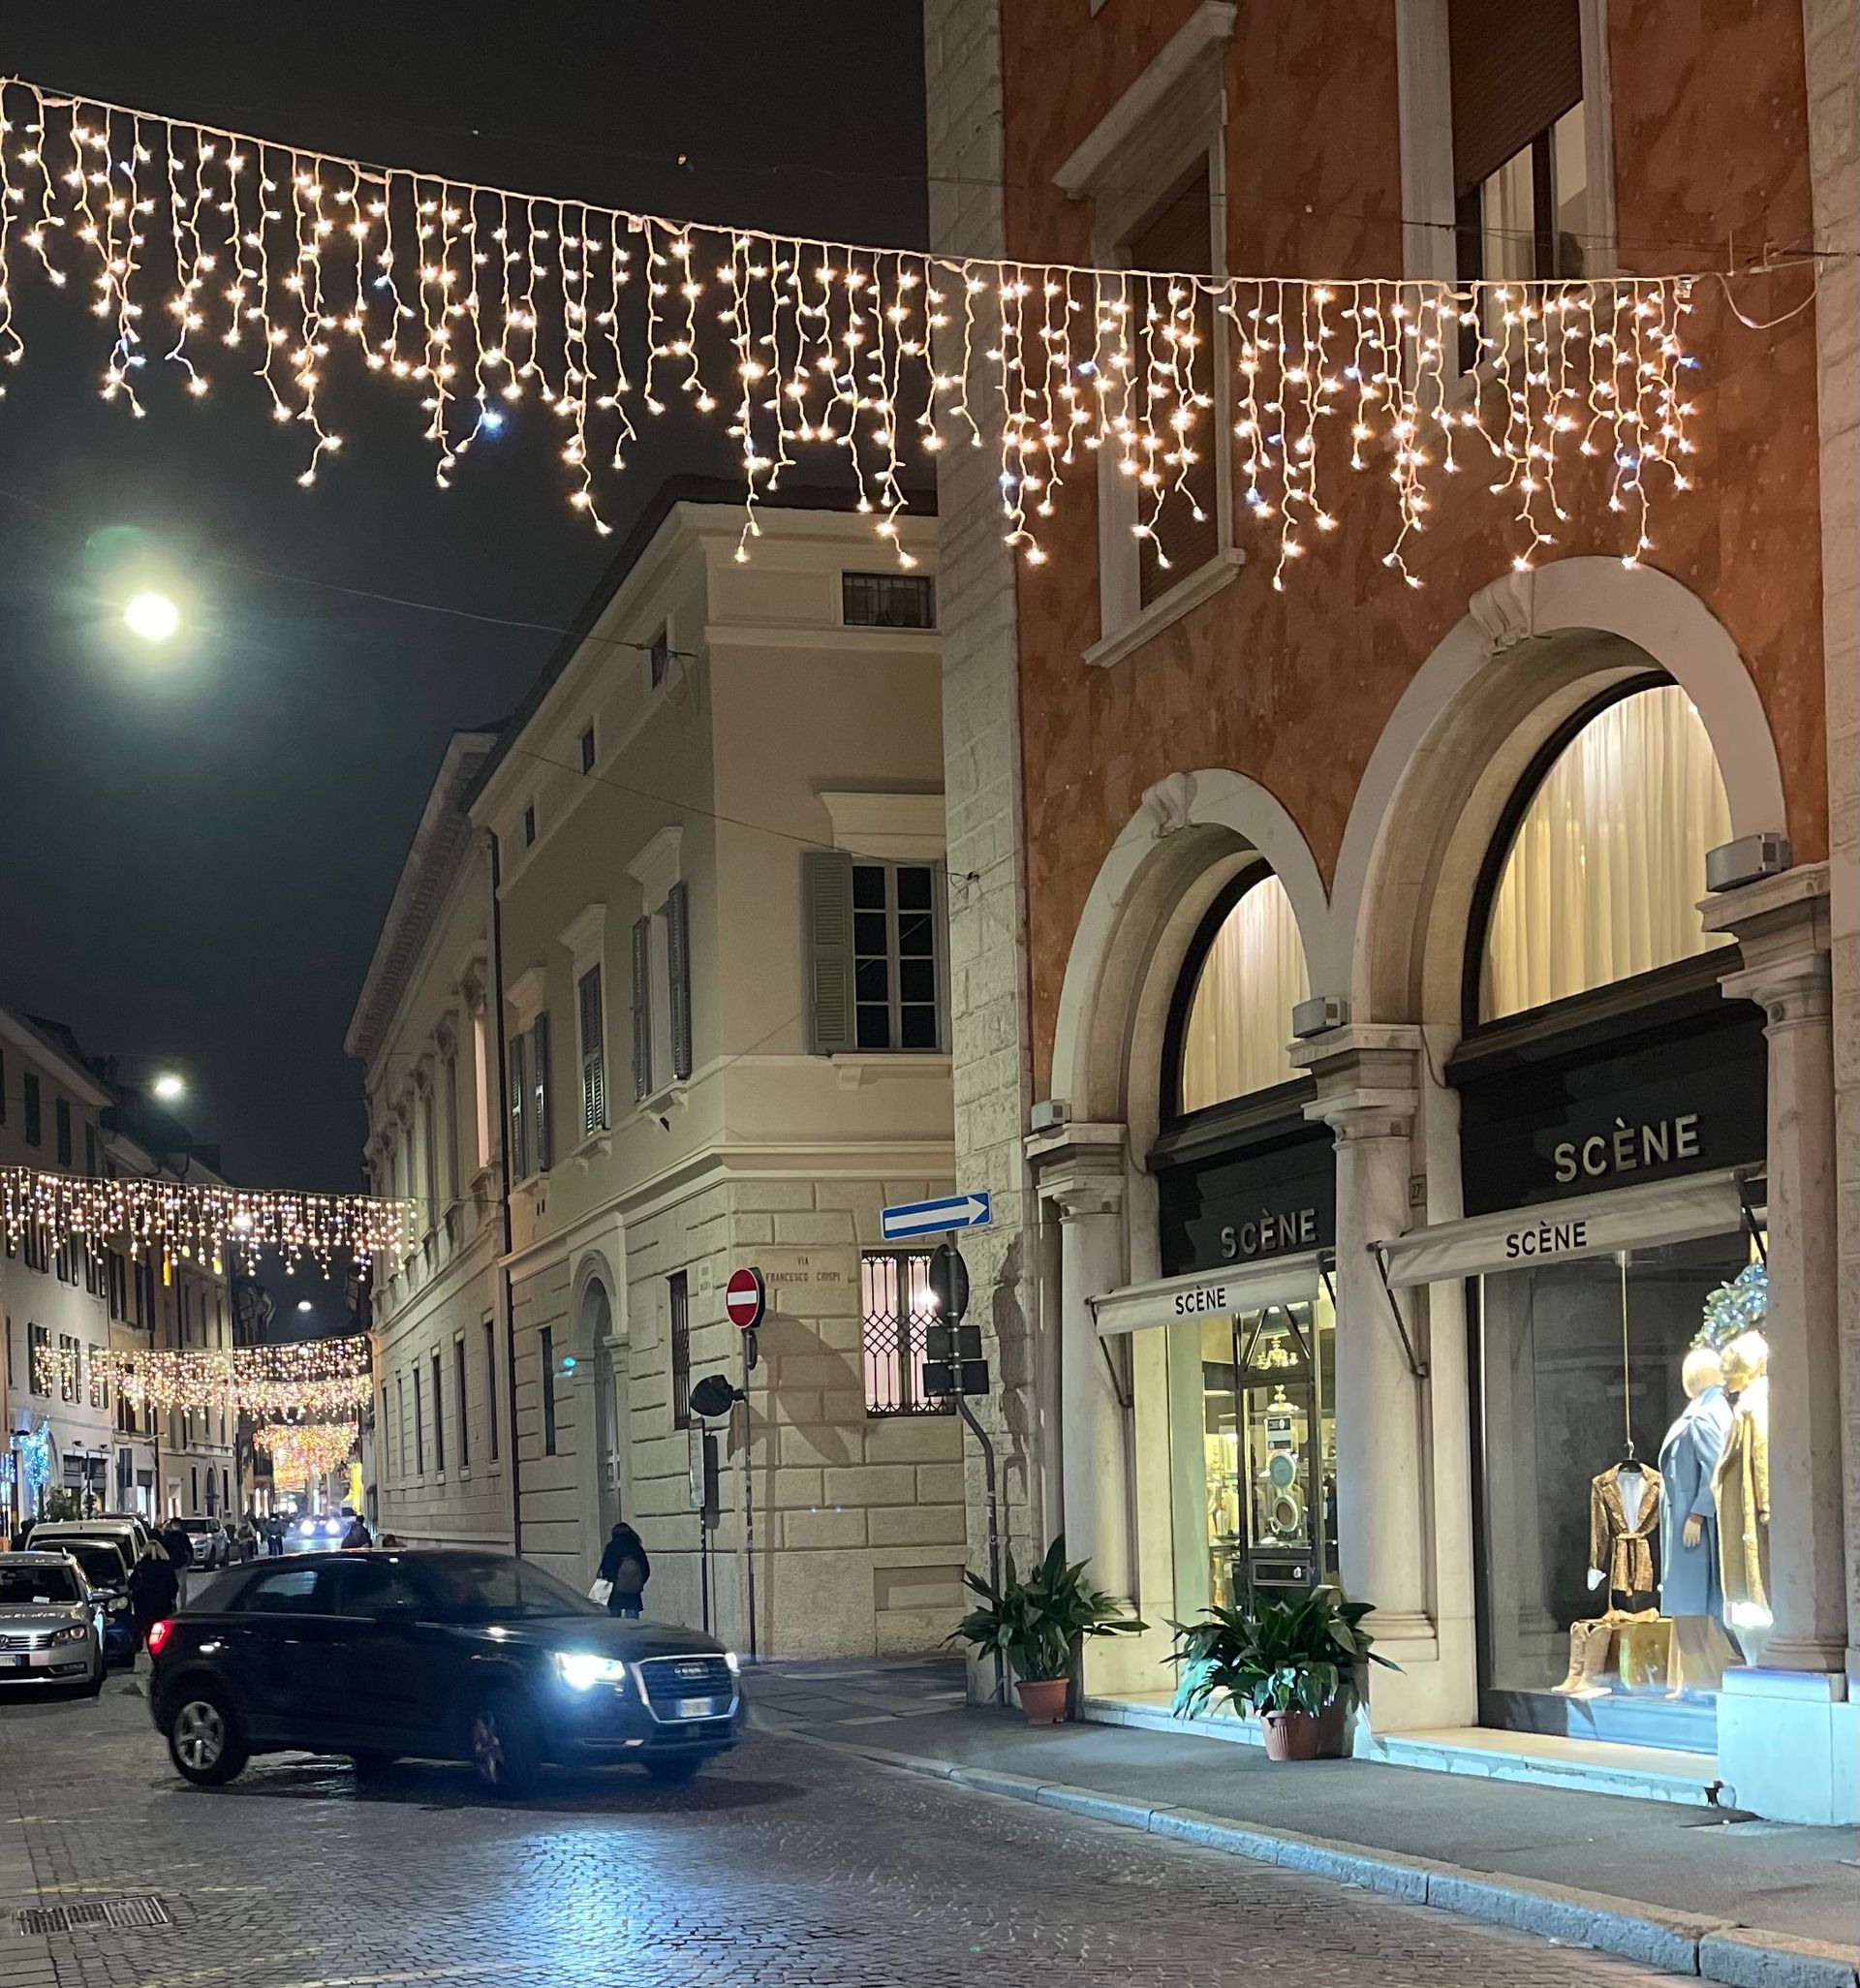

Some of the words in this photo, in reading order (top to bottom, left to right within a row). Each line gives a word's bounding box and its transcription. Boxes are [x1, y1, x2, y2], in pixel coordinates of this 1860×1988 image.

[1554, 1113, 1700, 1183] SCÈNE
[1221, 1208, 1317, 1258] SCÈNE
[1505, 1221, 1587, 1258] SCÈNE
[765, 1271, 809, 1282] FRANCESCO
[816, 1270, 841, 1282] CRISPI
[797, 1257, 810, 1266] VIA
[1175, 1285, 1226, 1316] SCÈNE
